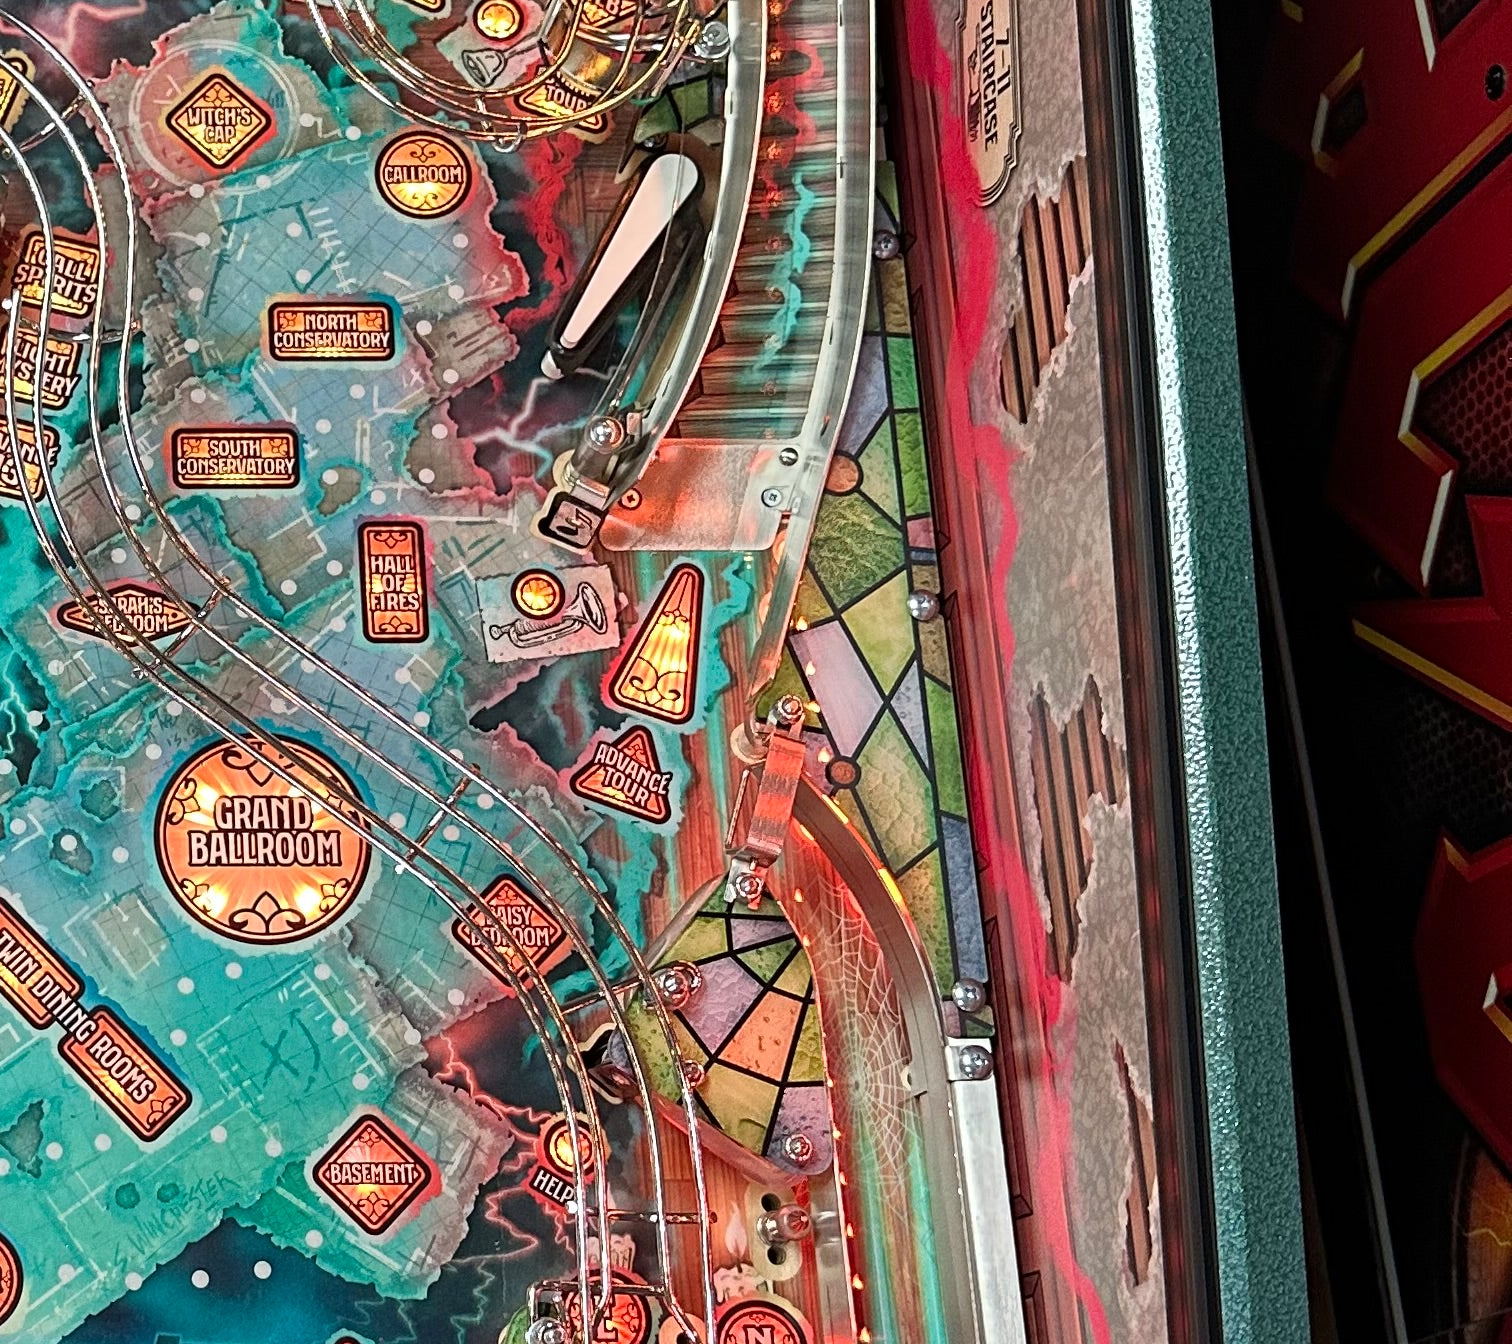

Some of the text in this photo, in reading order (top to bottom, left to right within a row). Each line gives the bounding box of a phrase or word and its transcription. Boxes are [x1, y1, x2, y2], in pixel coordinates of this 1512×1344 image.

[980, 0, 998, 153] STAIRCASE
[188, 107, 252, 126] WITCH'S
[204, 125, 236, 144] CAP
[384, 165, 464, 184] CALLROOM
[15, 262, 97, 304] SPRITS
[305, 312, 357, 331] NORTH
[274, 331, 390, 350] CONSERVATORY
[208, 439, 261, 457] SOUTH
[177, 457, 296, 476] CONSERVATORY
[370, 556, 415, 573] HALL
[380, 574, 404, 592] OF
[369, 592, 420, 611] FIRES
[594, 743, 671, 795] ADVANCE
[603, 766, 649, 807] TOUR
[215, 797, 313, 830] GRAND
[190, 831, 340, 866] BALLROOM
[31, 976, 97, 1045] DINING
[89, 1034, 156, 1103] ROOMS
[330, 1163, 415, 1185] BASEMENT
[533, 1170, 575, 1203] HELP
